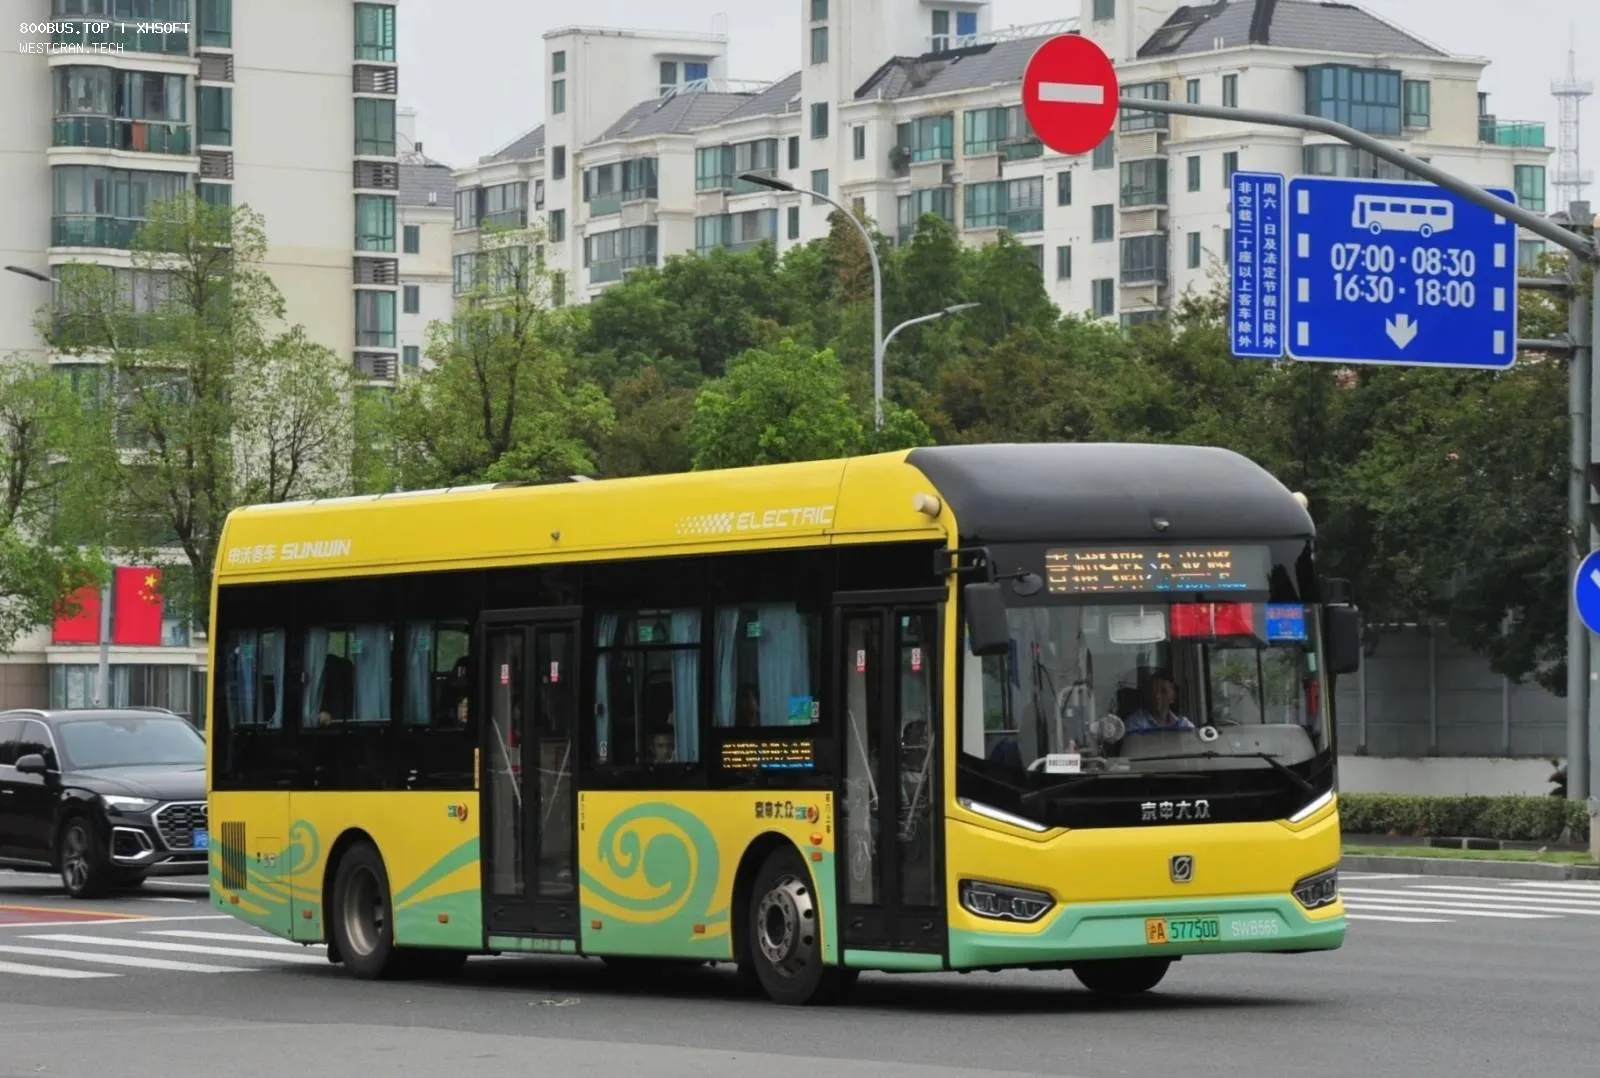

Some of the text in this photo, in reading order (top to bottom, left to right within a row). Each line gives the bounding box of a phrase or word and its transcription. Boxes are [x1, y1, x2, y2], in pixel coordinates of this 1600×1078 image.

[1330, 243, 1395, 274] 07:00
[1411, 247, 1476, 277] 08:30
[1333, 273, 1395, 304] 16:30
[1414, 278, 1476, 308] 18:00
[736, 505, 834, 531] ELECTRIC
[280, 539, 352, 561] SUNWIN
